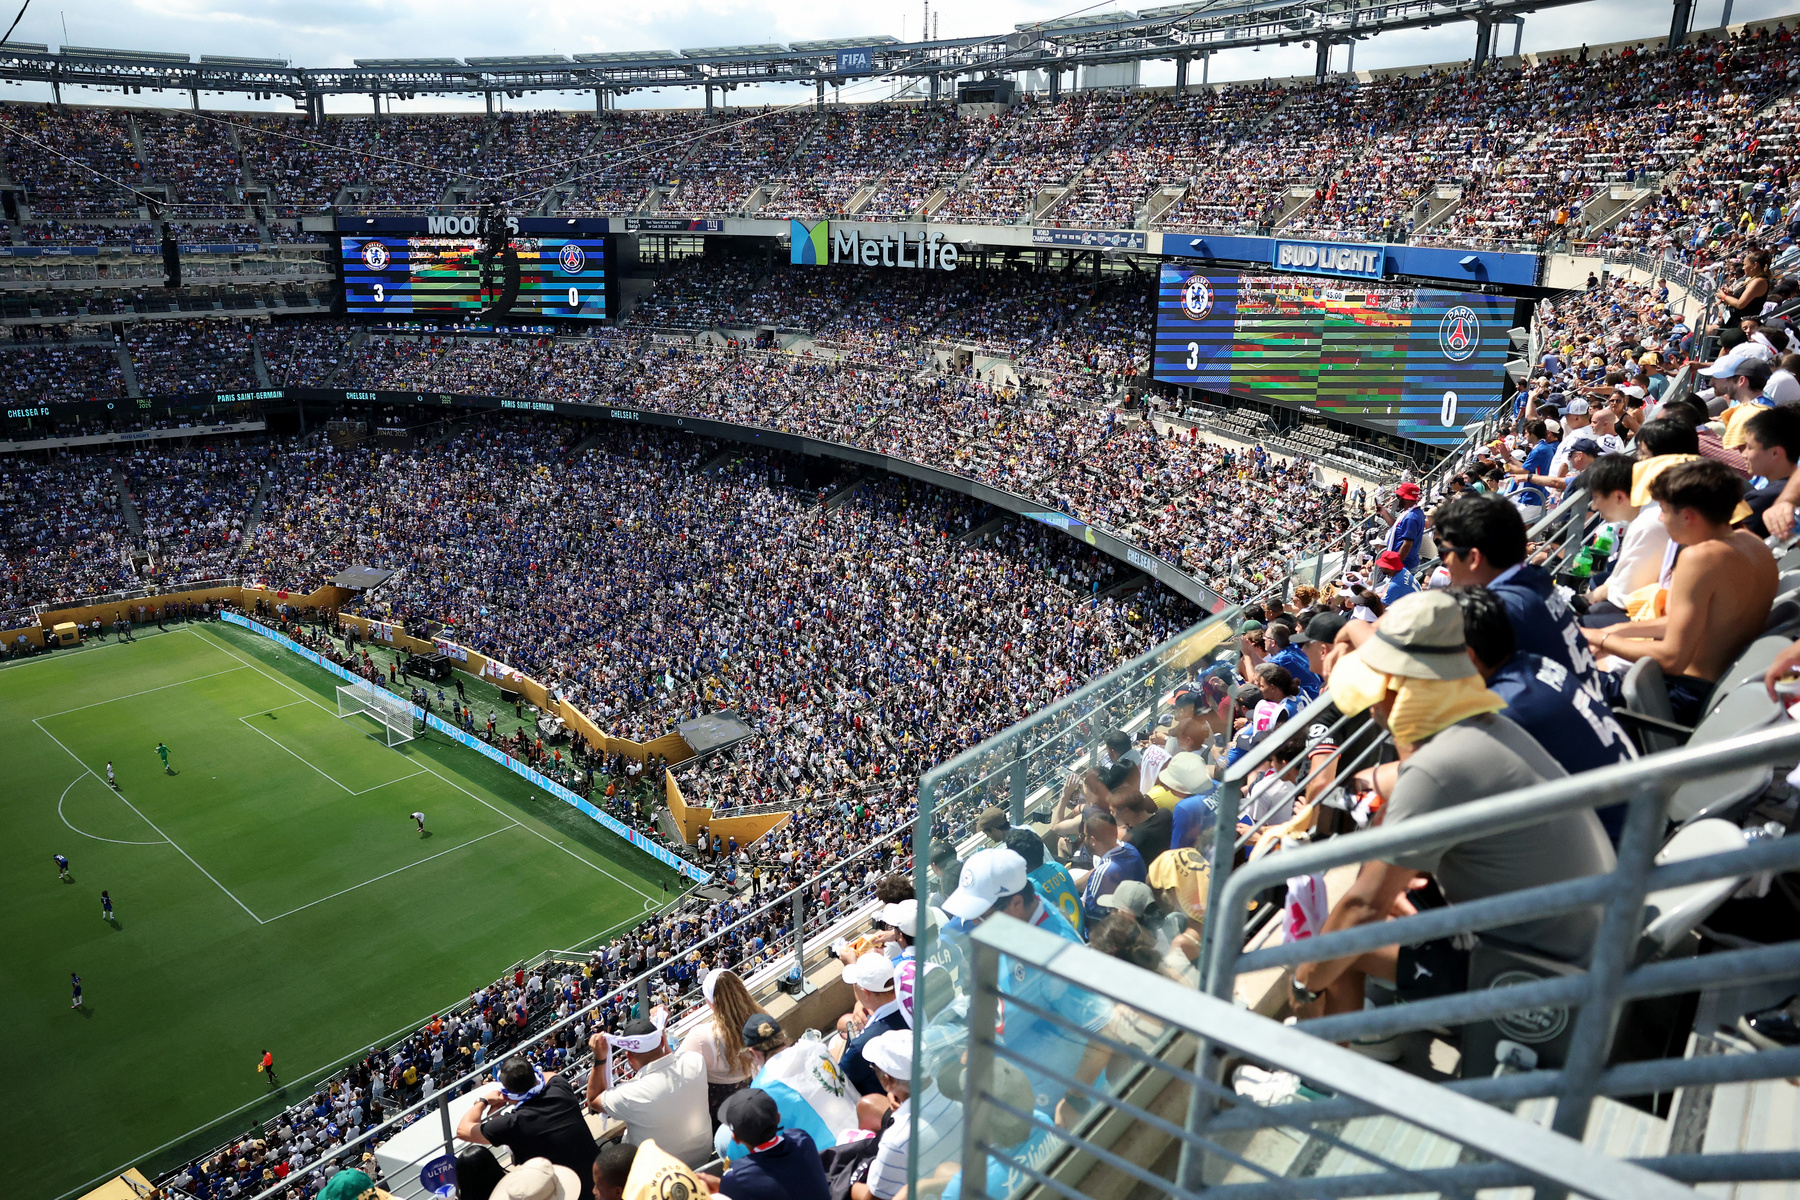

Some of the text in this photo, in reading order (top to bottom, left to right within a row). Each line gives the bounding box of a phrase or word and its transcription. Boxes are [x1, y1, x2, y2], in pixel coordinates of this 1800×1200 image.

[842, 53, 866, 66] FIFA
[427, 215, 520, 235] MOOS
[833, 229, 959, 271] MetLife
[1279, 244, 1318, 267] BUD
[1187, 276, 1209, 287] CHELSEA
[373, 283, 384, 303] 3
[568, 287, 579, 307] 0
[1448, 308, 1475, 324] PARIS
[1186, 341, 1200, 371] 3
[217, 390, 284, 403] PARIS SAINT-GERMAIN
[346, 392, 377, 400] CHELSEA FC
[501, 400, 555, 412] PARIS SAINT-GERMAIN
[8, 407, 50, 418] CHELSEA FC
[610, 409, 640, 420] CHELSEA FC
[1440, 390, 1458, 428] 0
[1126, 548, 1151, 572] CHELSEA
[251, 621, 274, 640] ULTRA
[275, 632, 294, 649] ZERO
[322, 658, 346, 678] ULTRA
[440, 719, 466, 744] ZERO
[471, 738, 579, 807] Michelob ULTRA ZERO
[590, 805, 627, 837] Michelob
[635, 833, 677, 870] ULTRA
[1042, 871, 1067, 894] ETO'O
[1058, 891, 1080, 930] 9
[926, 948, 952, 966] OLA
[427, 1163, 454, 1178] ULTRA
